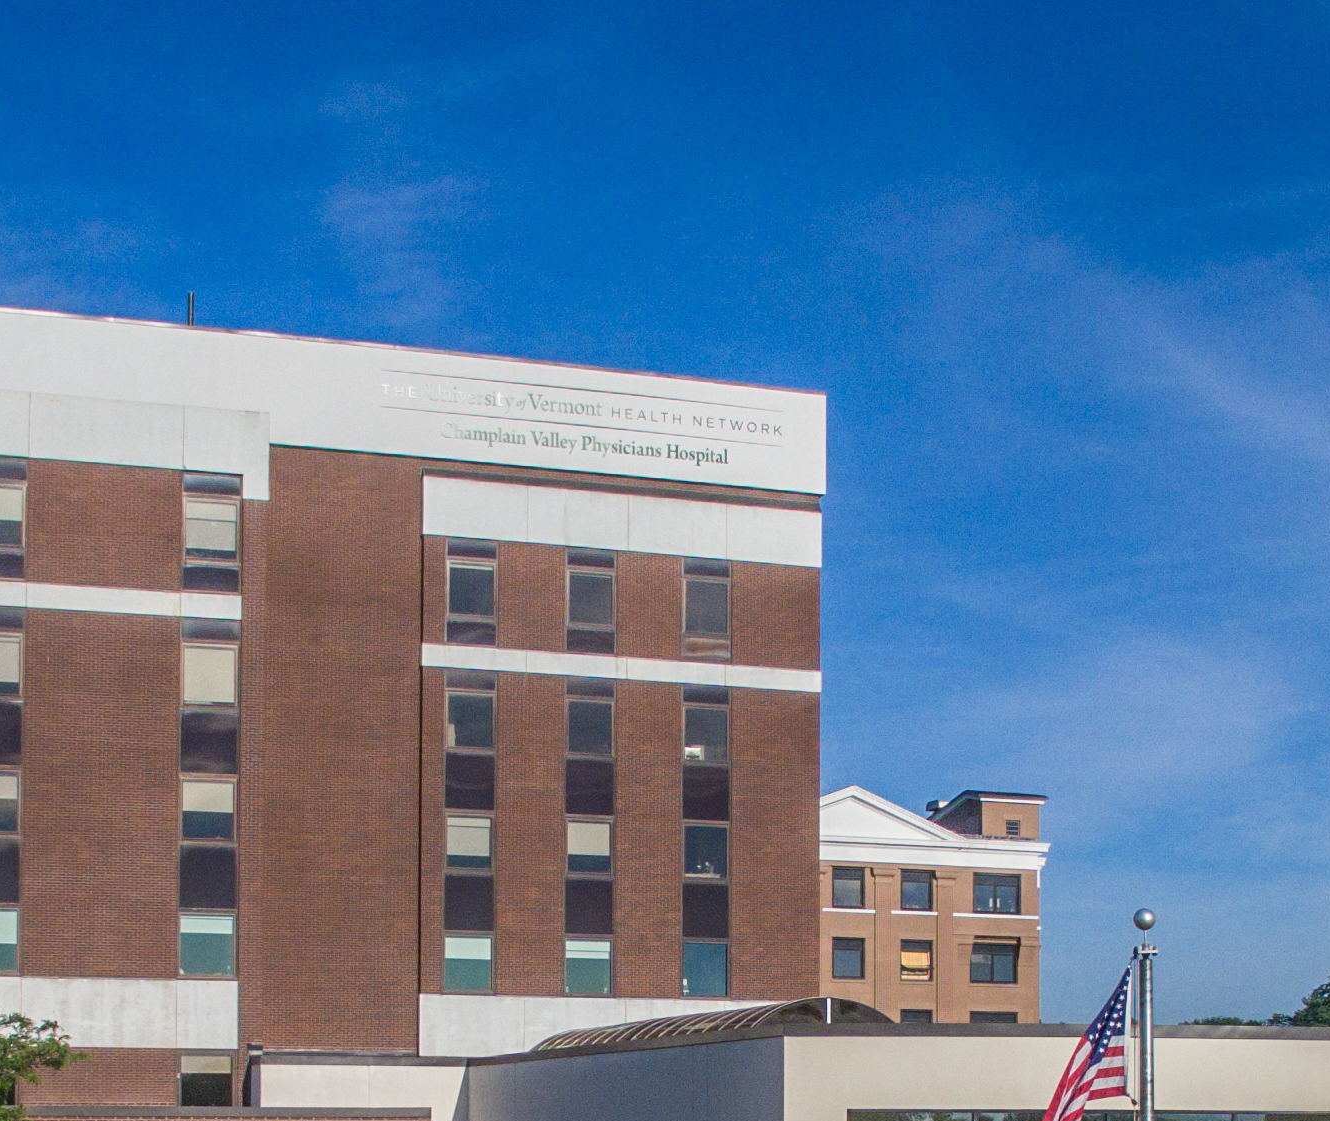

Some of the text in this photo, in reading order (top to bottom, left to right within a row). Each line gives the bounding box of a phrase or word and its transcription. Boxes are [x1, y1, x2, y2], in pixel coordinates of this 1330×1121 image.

[380, 383, 418, 399] THE
[516, 396, 528, 410] of
[528, 393, 603, 416] Vermont
[610, 407, 683, 425] HEALTH
[692, 416, 784, 437] NETWORK
[440, 422, 729, 466] Champlain Valley Physicians Hospital
